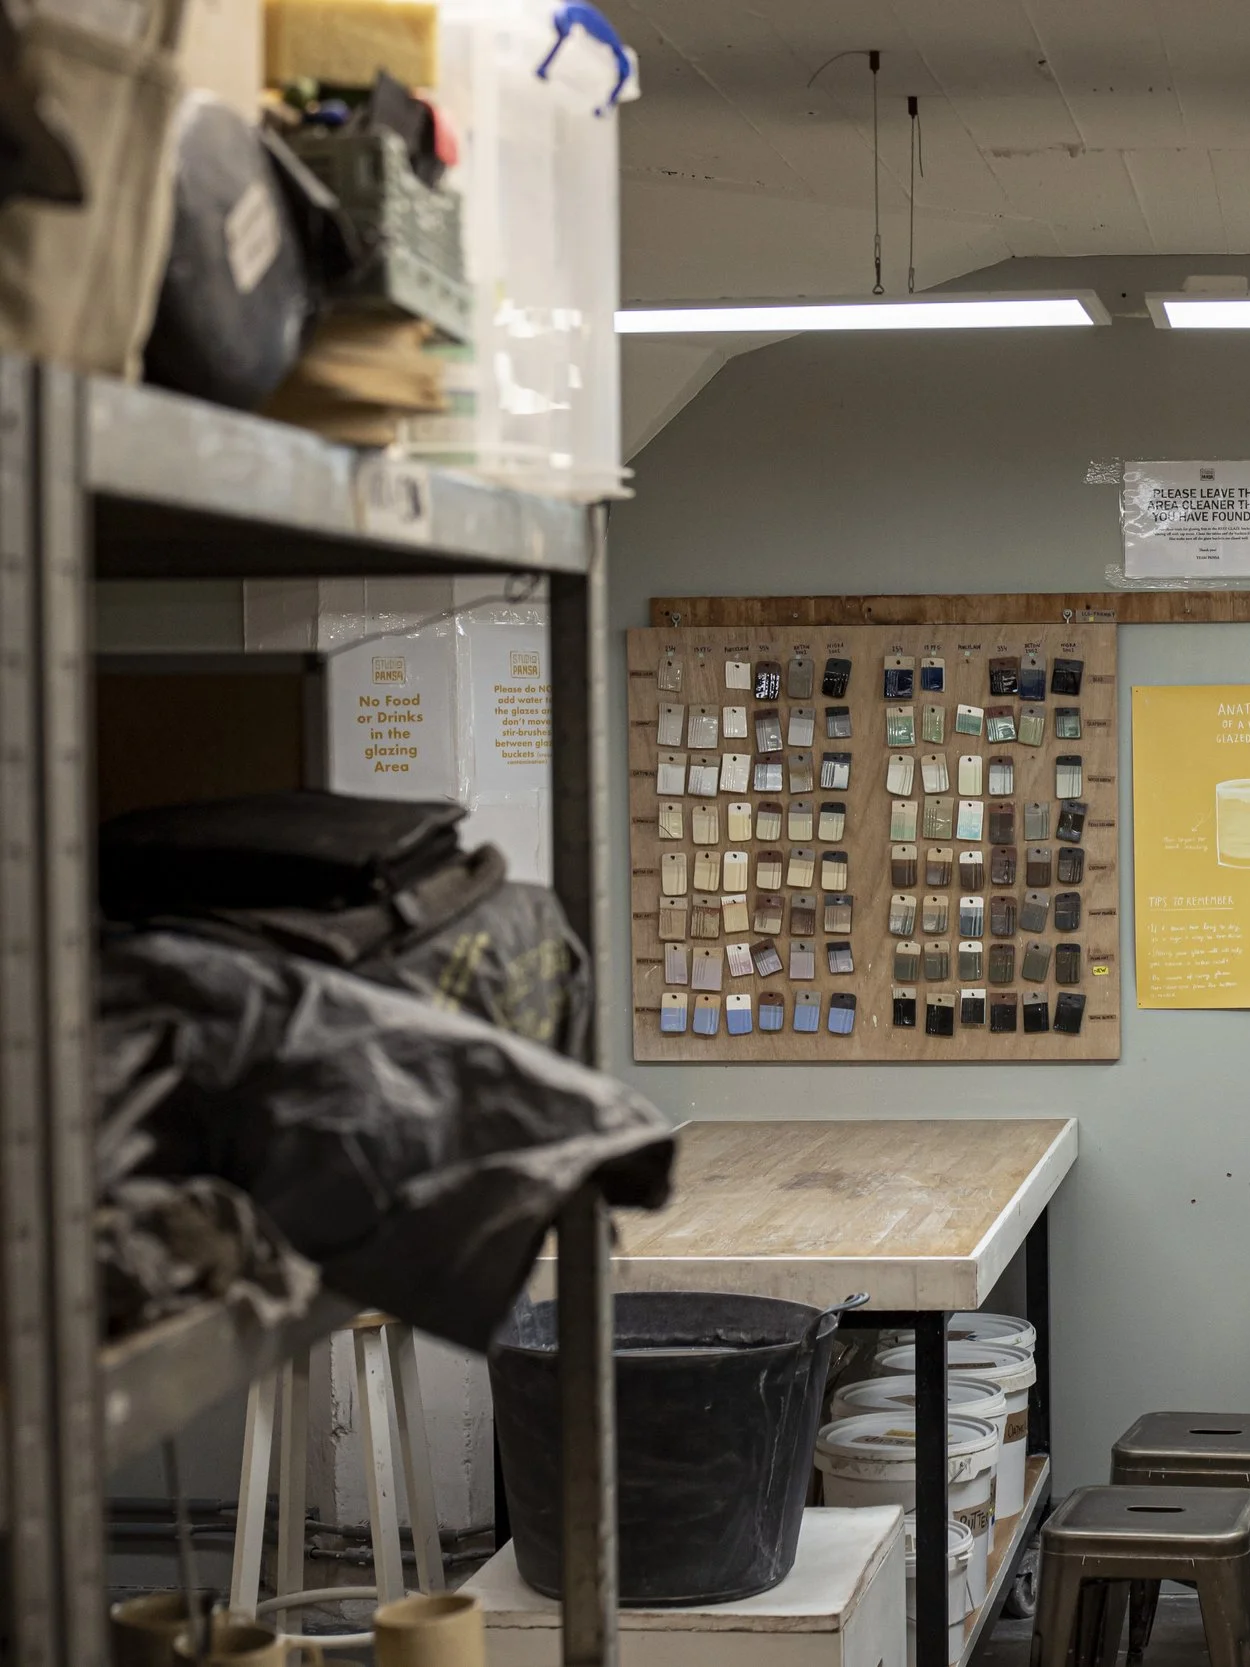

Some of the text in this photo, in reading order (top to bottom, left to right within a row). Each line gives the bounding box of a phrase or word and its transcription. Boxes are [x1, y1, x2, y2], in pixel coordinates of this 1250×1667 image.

[1153, 488, 1196, 498] PLEASE
[1200, 488, 1235, 498] LEAVE
[1148, 500, 1178, 510] AREA
[1181, 499, 1234, 510] CLEANER
[1152, 511, 1175, 522] YOU
[1179, 511, 1208, 522] HAVE
[513, 664, 538, 676] PANSA
[374, 670, 404, 682] PANSA
[494, 684, 522, 694] Please
[524, 684, 536, 693] do
[358, 693, 420, 707] No Food
[497, 695, 515, 704] add
[517, 696, 543, 704] water
[494, 706, 509, 715] the
[511, 706, 539, 716] glazes
[356, 710, 424, 724] or Drinks
[1222, 719, 1233, 729] OF
[1237, 720, 1245, 730] A
[370, 727, 411, 740] in the
[502, 728, 552, 737] stir-brushes
[495, 739, 533, 748] between
[364, 743, 418, 760] glazing
[501, 750, 535, 758] buckets
[374, 761, 409, 773] Area
[1148, 895, 1234, 907] TIPS TO REMEMBER
